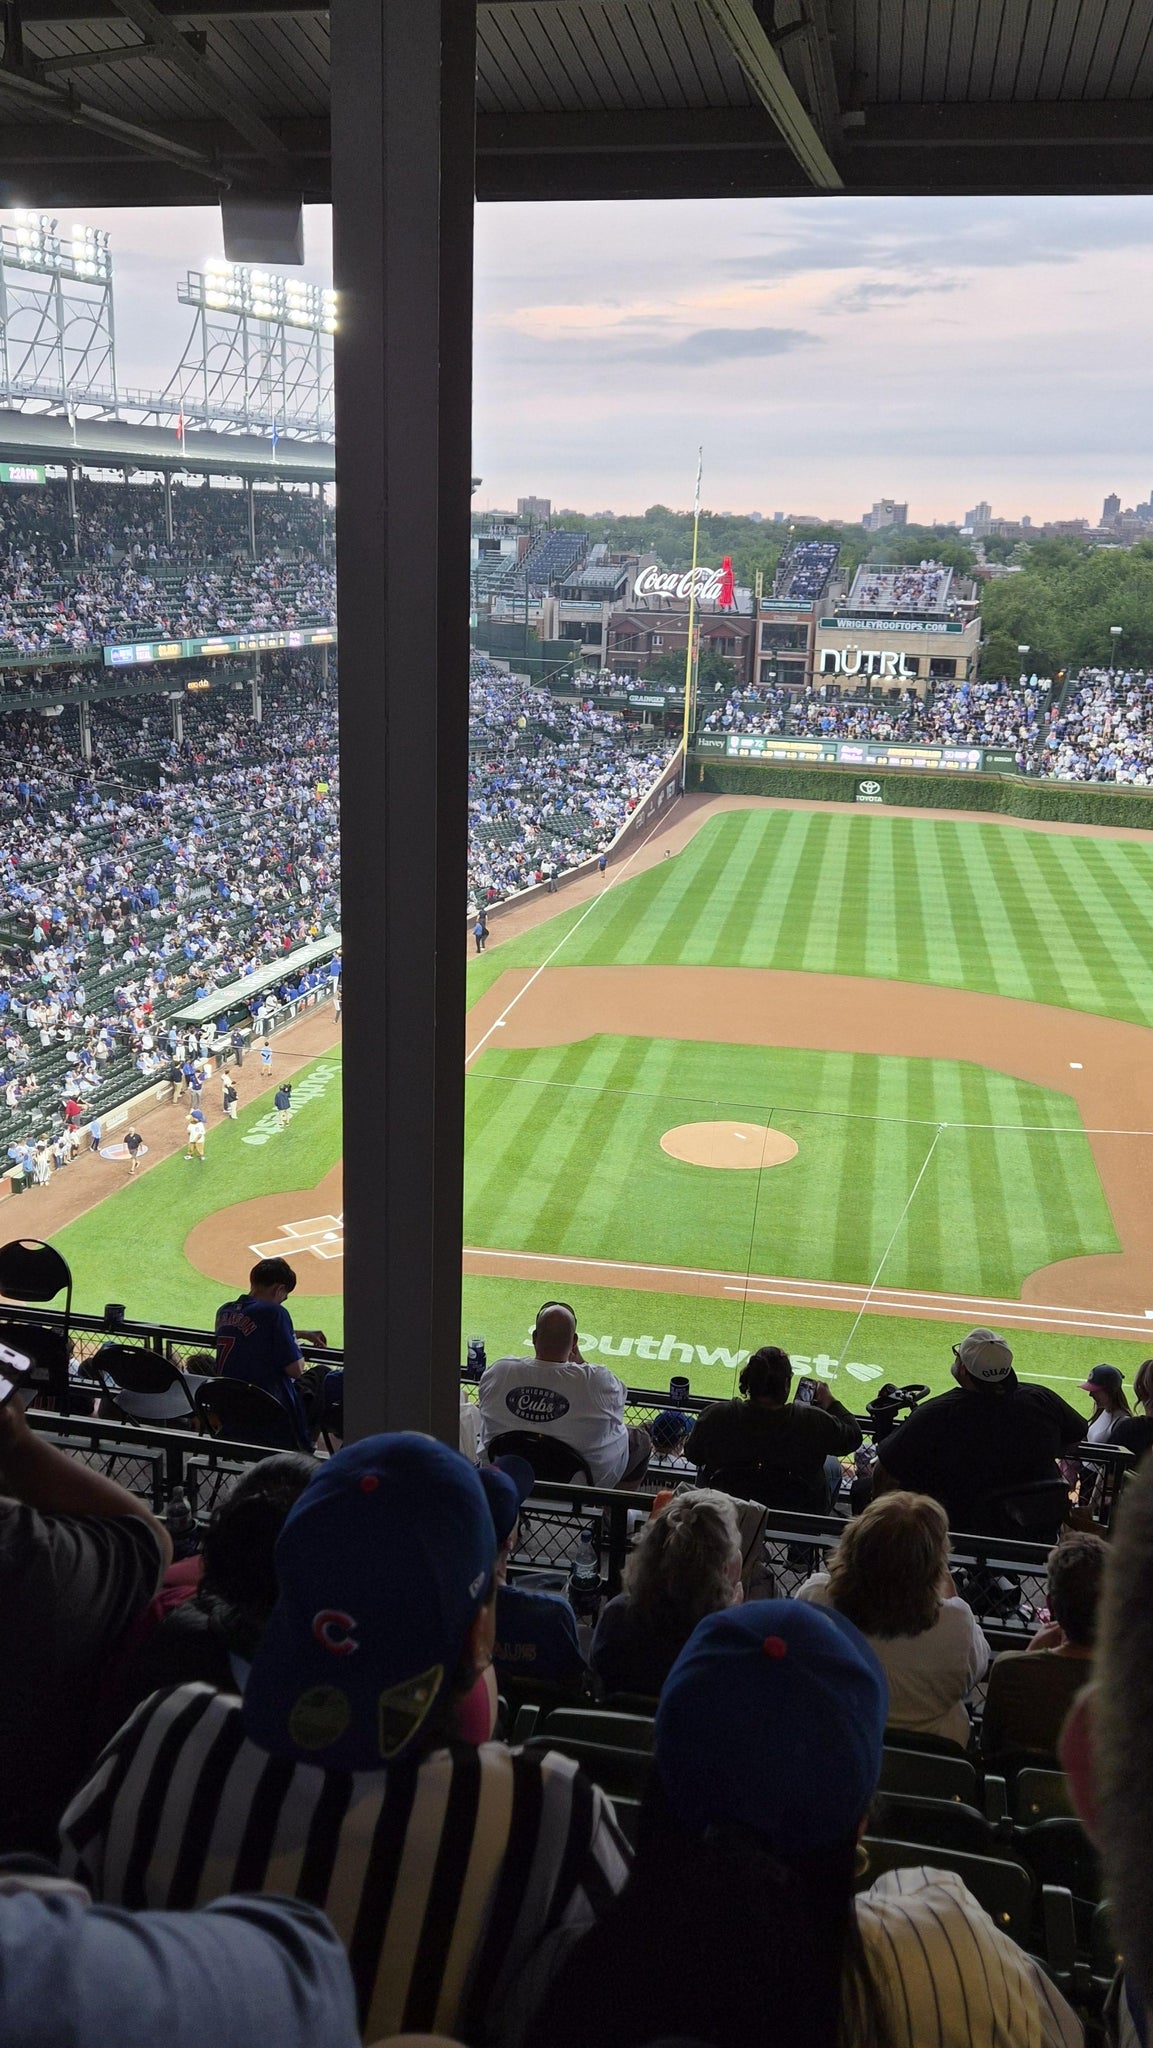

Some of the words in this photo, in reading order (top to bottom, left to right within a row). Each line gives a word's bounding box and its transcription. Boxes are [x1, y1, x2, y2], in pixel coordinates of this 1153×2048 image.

[837, 619, 947, 632] WRIGLEYROOFTOPS.COM
[698, 737, 725, 748] Harvey
[856, 795, 883, 803] TOYOTA
[518, 1394, 555, 1413] Cubs
